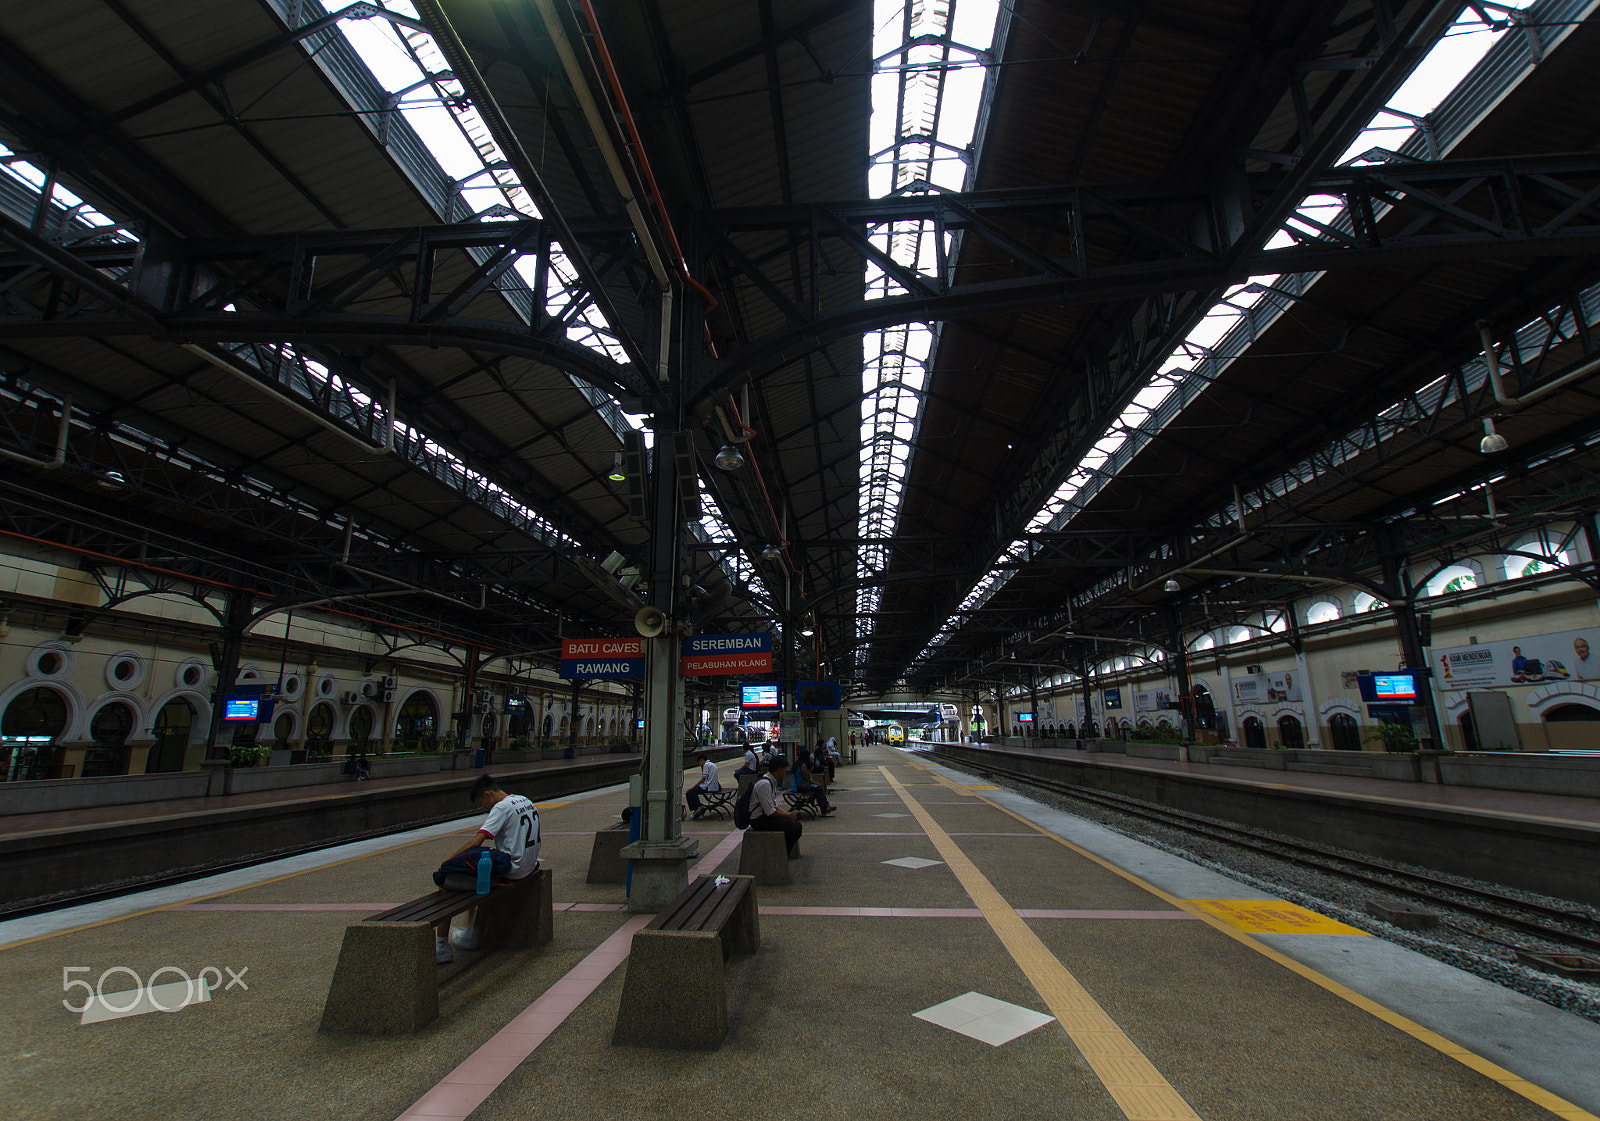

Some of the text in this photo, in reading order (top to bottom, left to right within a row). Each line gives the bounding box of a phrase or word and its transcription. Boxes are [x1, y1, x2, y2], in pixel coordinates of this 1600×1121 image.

[568, 642, 640, 654] BATU CAVES
[692, 637, 762, 651] SEREMBAN
[576, 662, 630, 674] RAWANG
[687, 659, 767, 670] PELABUHAN KLANG
